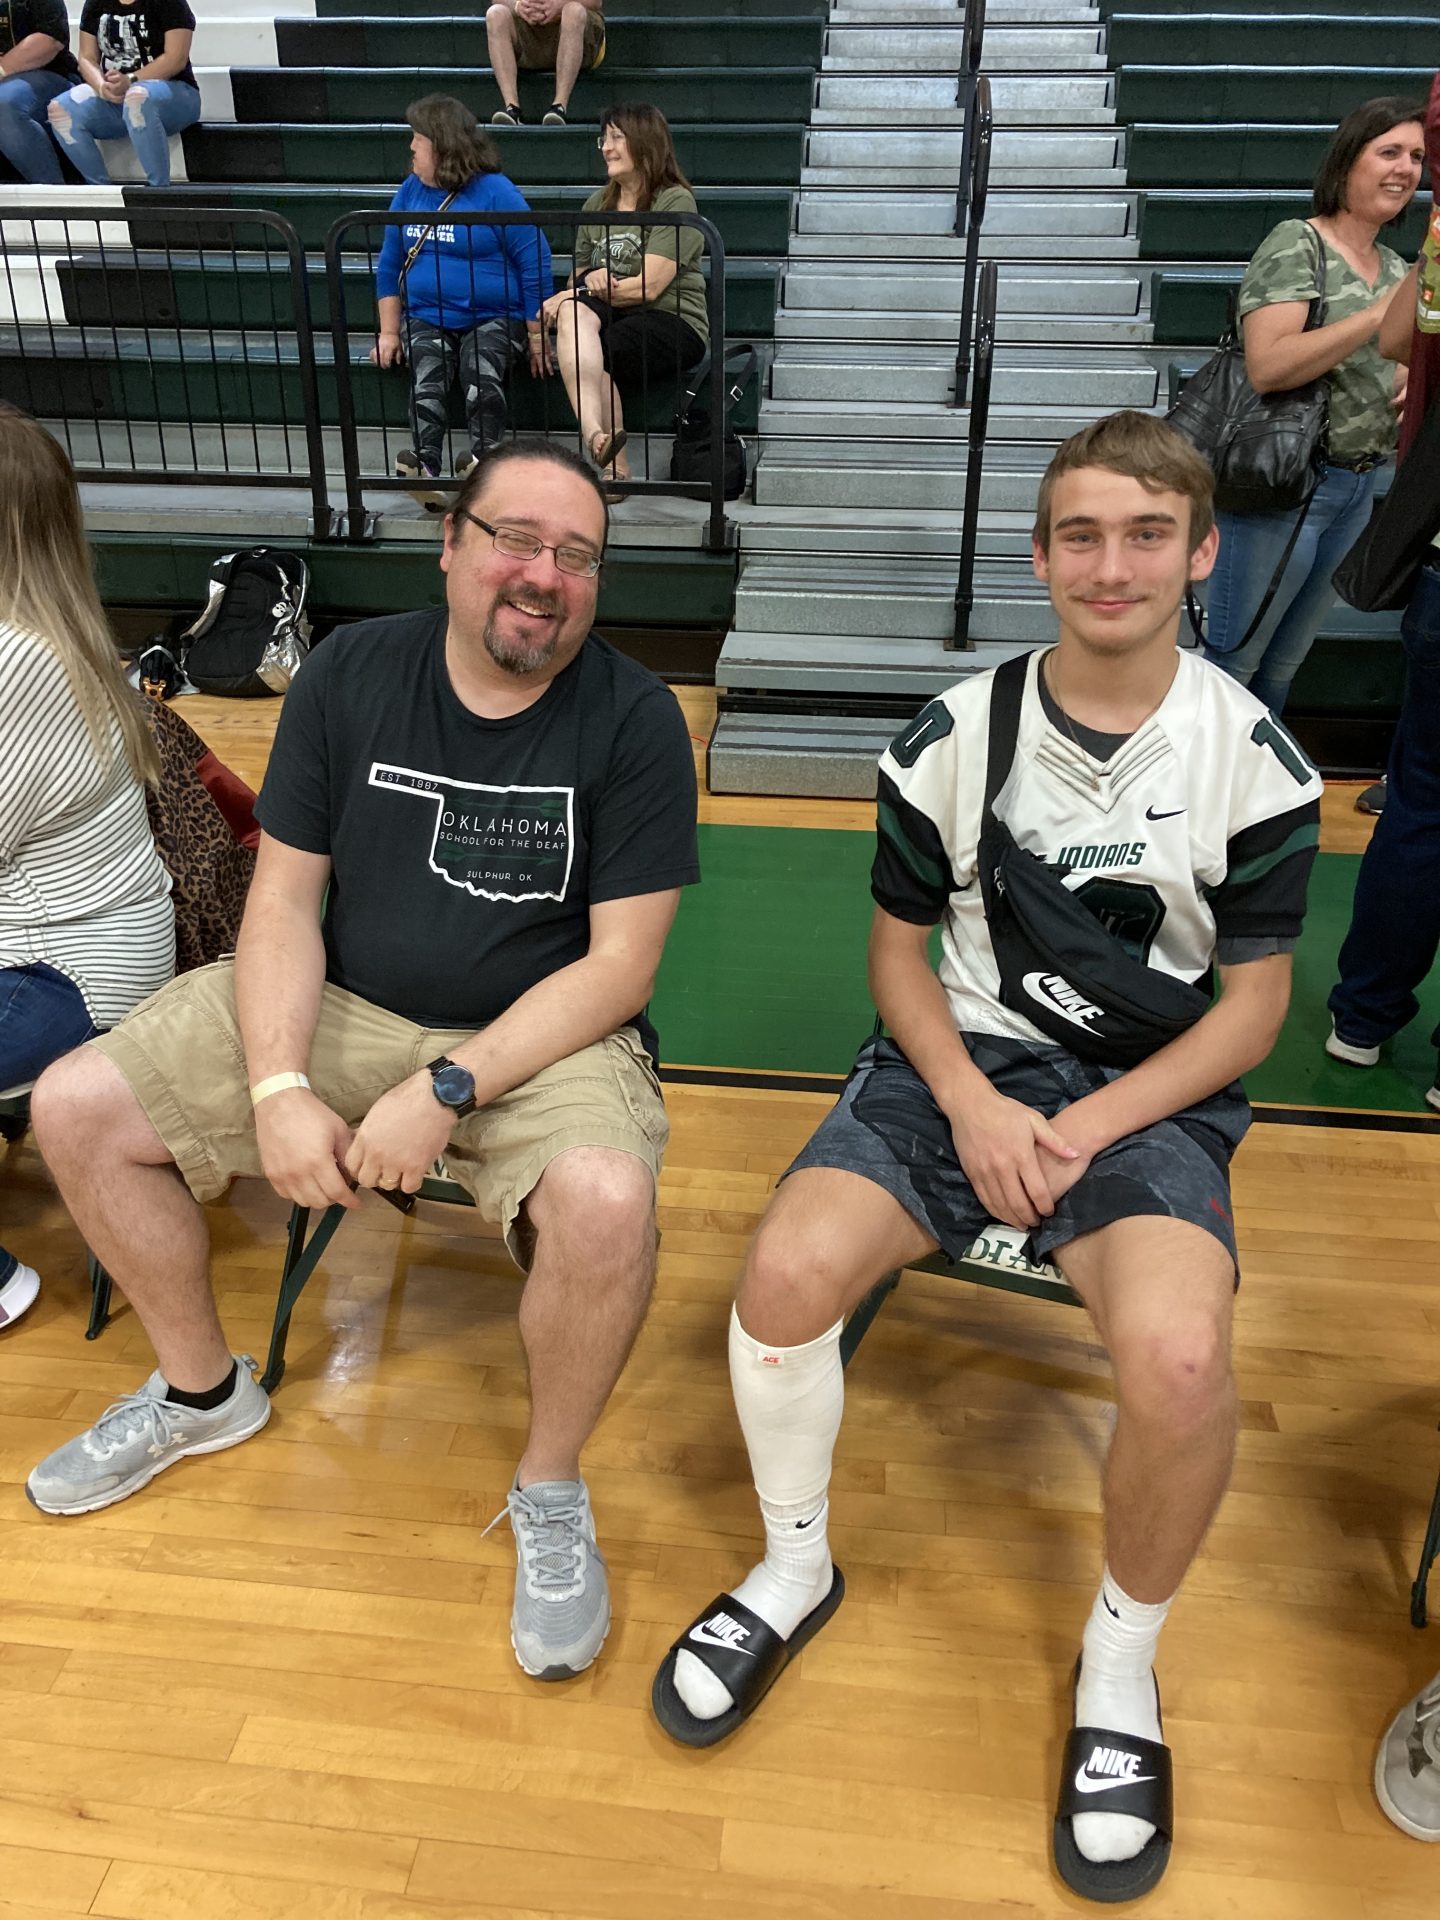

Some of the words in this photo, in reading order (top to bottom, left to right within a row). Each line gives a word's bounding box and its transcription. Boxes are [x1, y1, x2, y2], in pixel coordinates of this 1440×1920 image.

[380, 772, 401, 783] EST
[410, 778, 439, 791] 1987
[442, 811, 567, 837] OKLAHOMA
[439, 831, 480, 846] SCHOOL
[483, 837, 504, 847] FOR
[511, 839, 530, 848] THE
[536, 840, 566, 850] DEAF
[1057, 842, 1147, 869] INDIANS
[519, 873, 532, 881] OK
[1042, 975, 1105, 1023] NIKE
[762, 1356, 780, 1364] ACE
[704, 1611, 752, 1647] NIKE
[1086, 1746, 1142, 1778] NIKE
